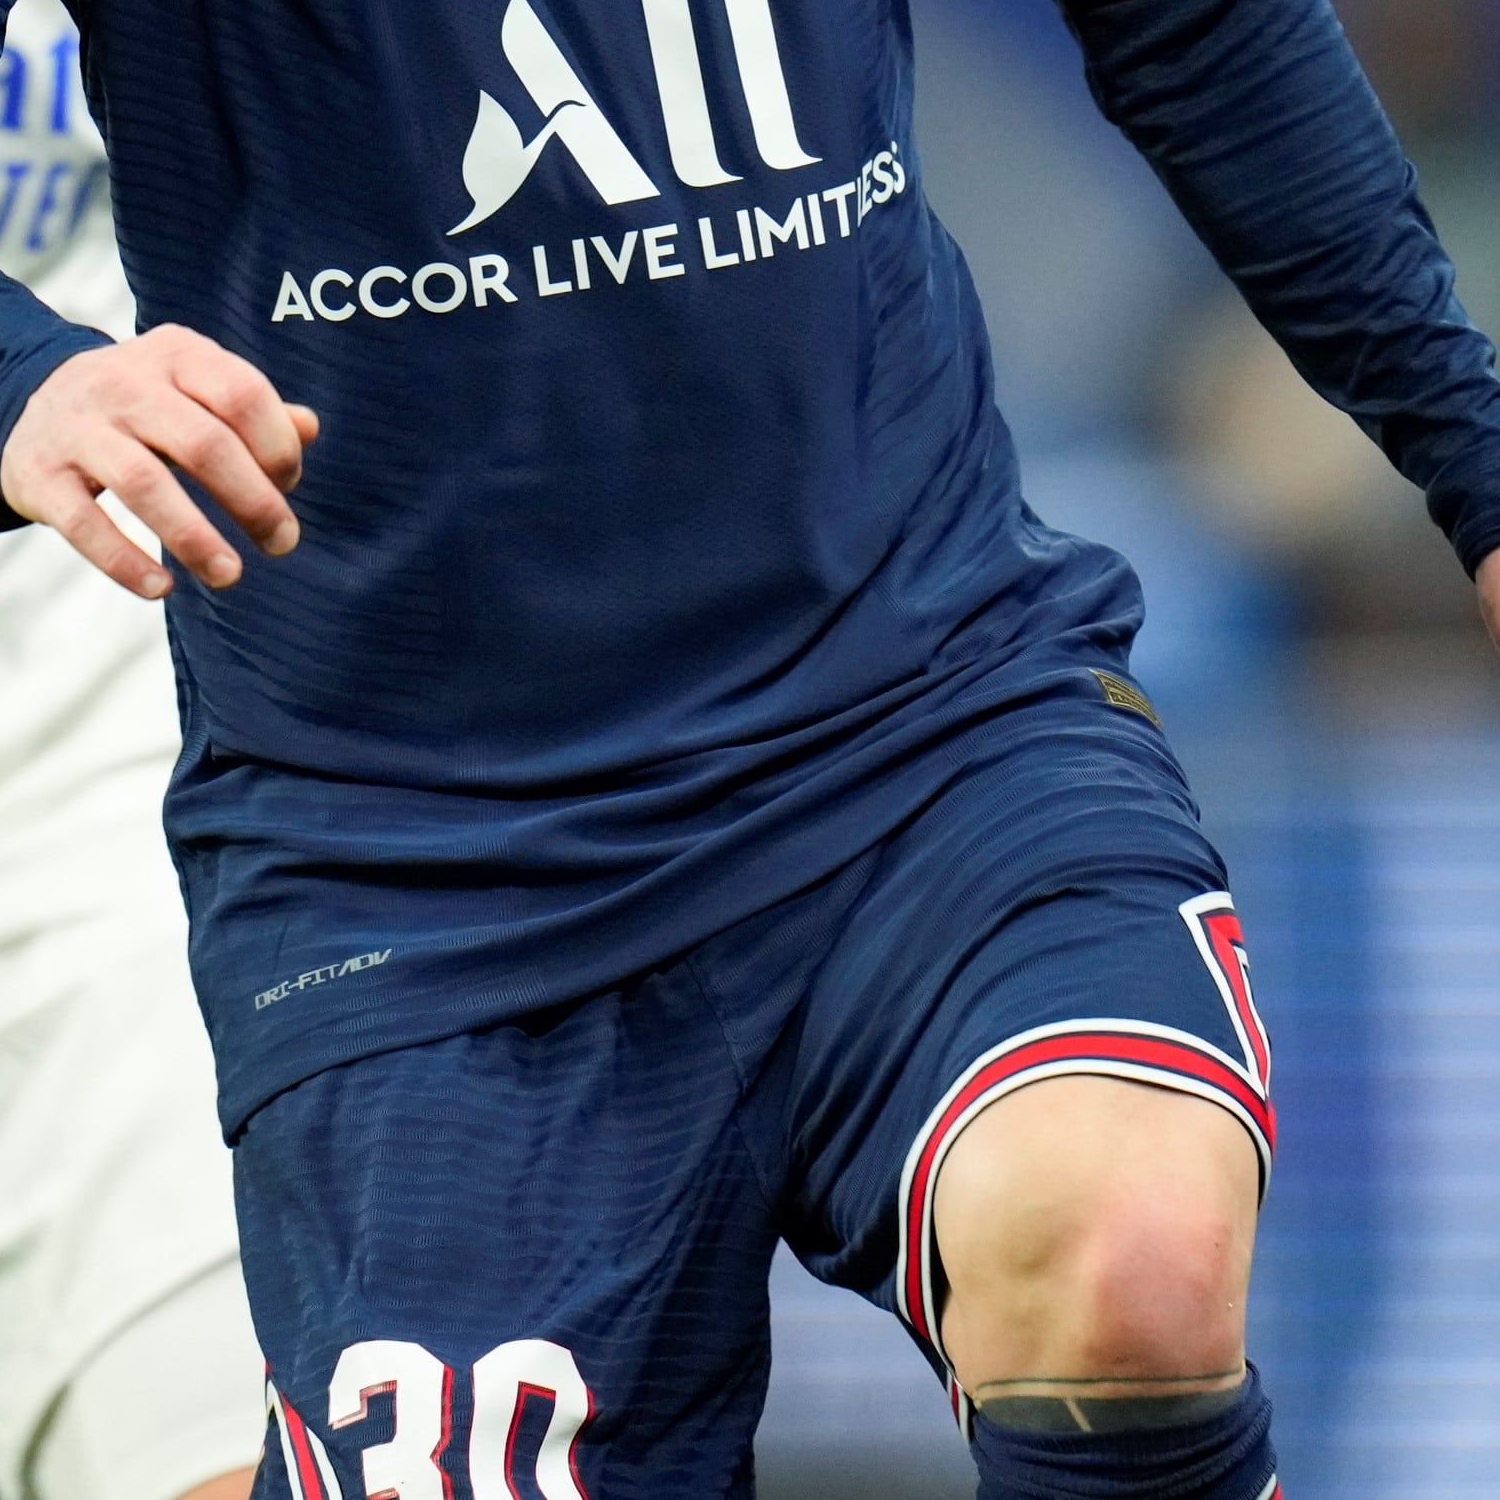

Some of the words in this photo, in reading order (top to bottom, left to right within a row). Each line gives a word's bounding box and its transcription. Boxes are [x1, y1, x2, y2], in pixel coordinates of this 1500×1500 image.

[271, 255, 518, 322] ACCOR
[533, 224, 685, 297] LIVE
[328, 1339, 595, 1500] 30
